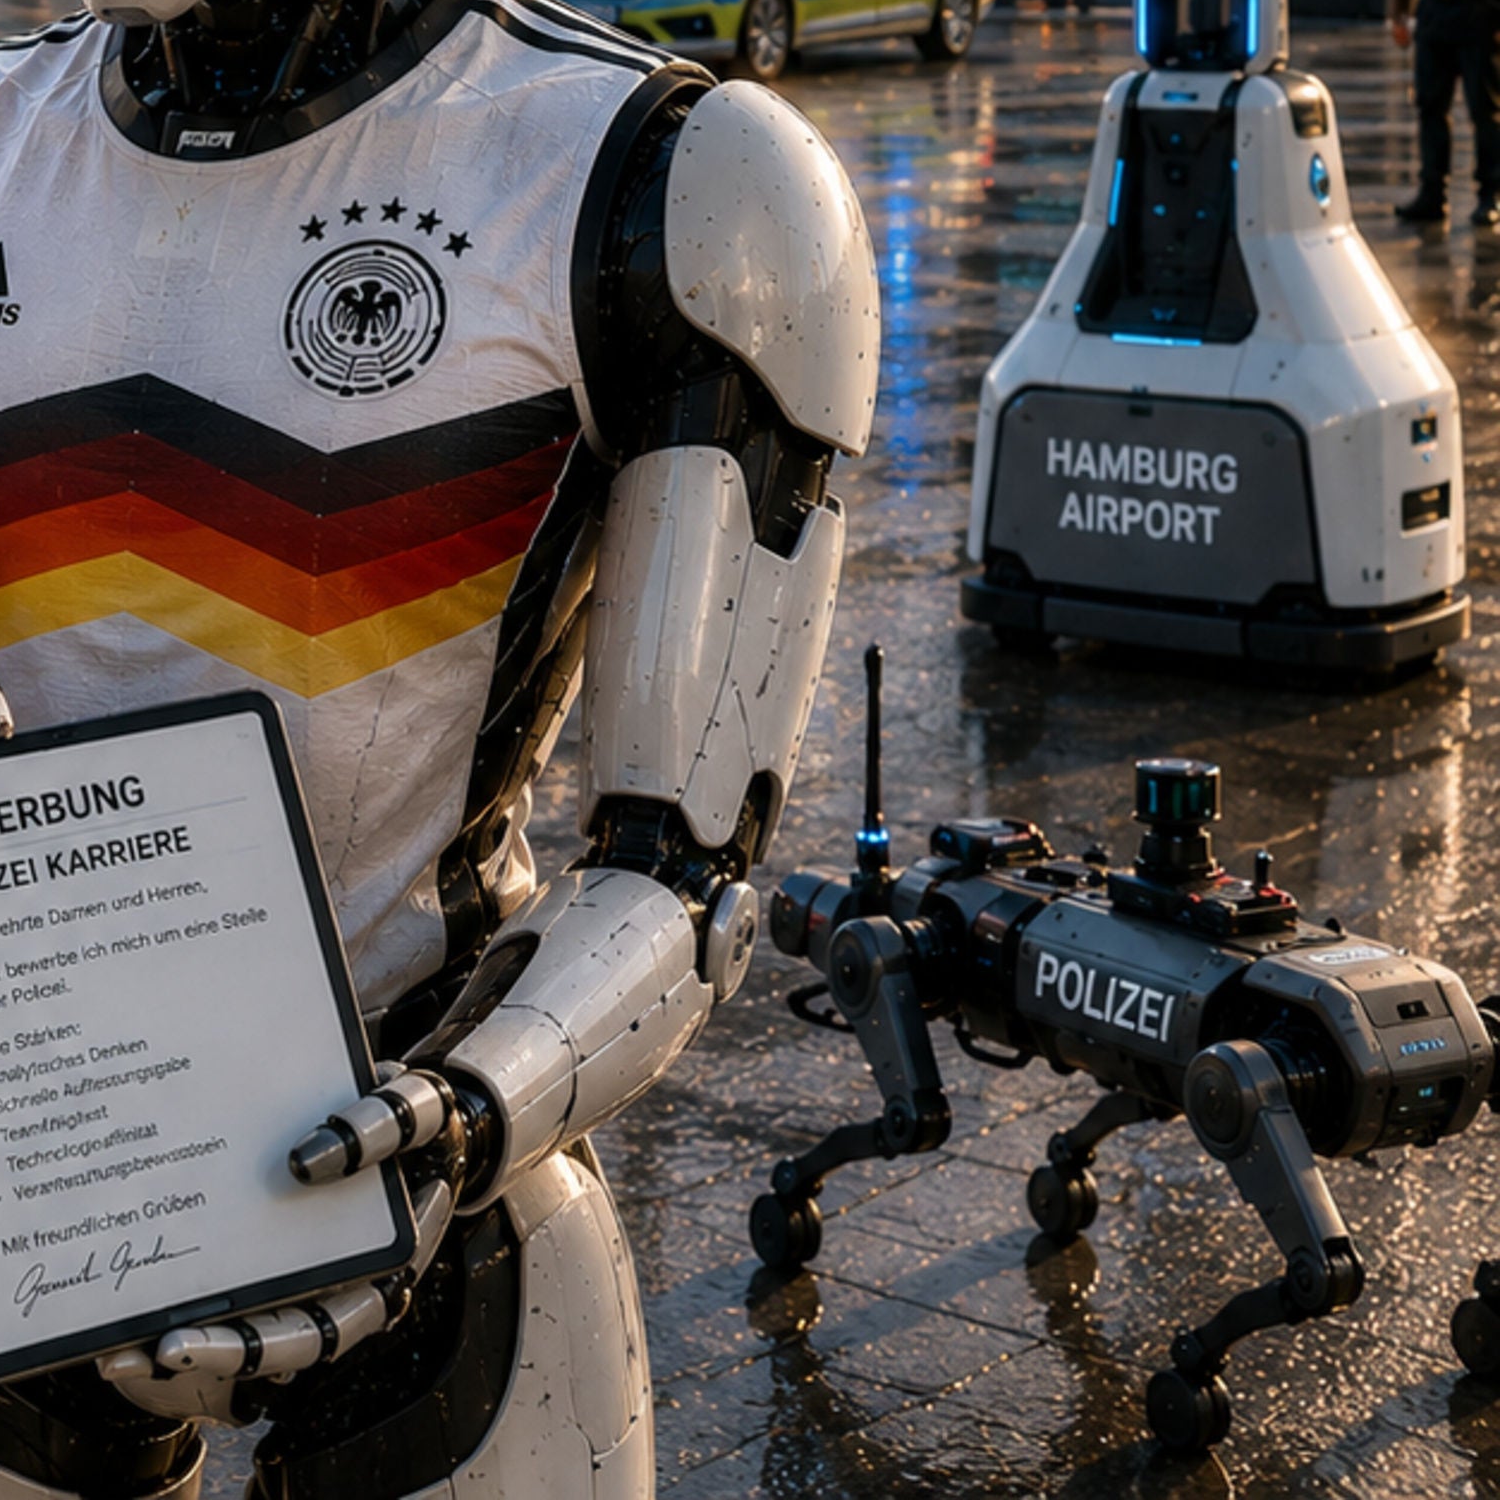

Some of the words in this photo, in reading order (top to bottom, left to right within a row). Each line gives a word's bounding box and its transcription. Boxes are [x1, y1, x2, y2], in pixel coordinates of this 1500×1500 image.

[1046, 438, 1238, 494] HAMBURG
[1058, 491, 1221, 544] AIRPORT
[45, 826, 192, 880] KARRIERE
[46, 901, 109, 928] Damen
[111, 888, 144, 912] und
[110, 932, 152, 955] mich
[153, 928, 182, 946] um
[183, 919, 220, 939] eine
[1036, 952, 1174, 1041] POLIZEI
